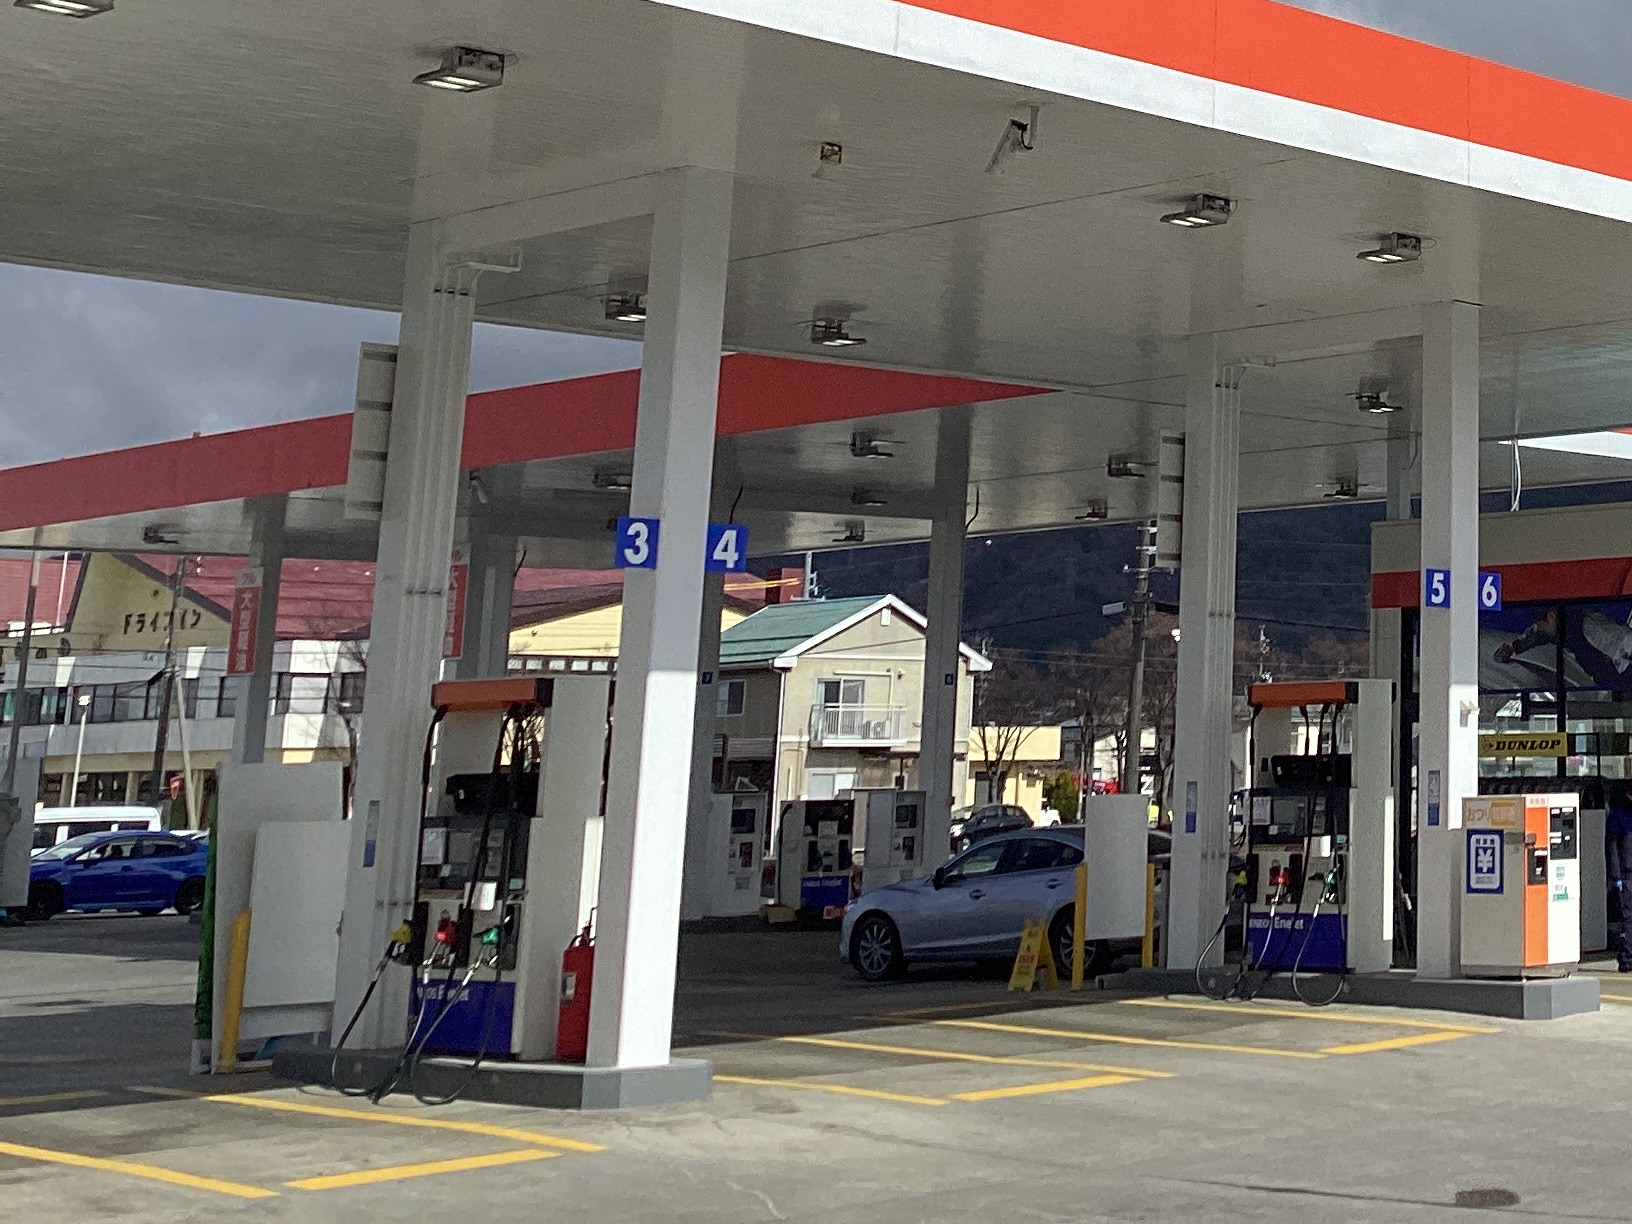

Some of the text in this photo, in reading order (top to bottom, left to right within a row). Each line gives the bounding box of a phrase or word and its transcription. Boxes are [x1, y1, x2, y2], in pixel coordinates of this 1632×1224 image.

[624, 521, 649, 565] 3
[713, 529, 739, 569] 4
[1430, 572, 1445, 604] 5
[1482, 576, 1497, 607] 6
[1495, 740, 1561, 751] DUNLOP
